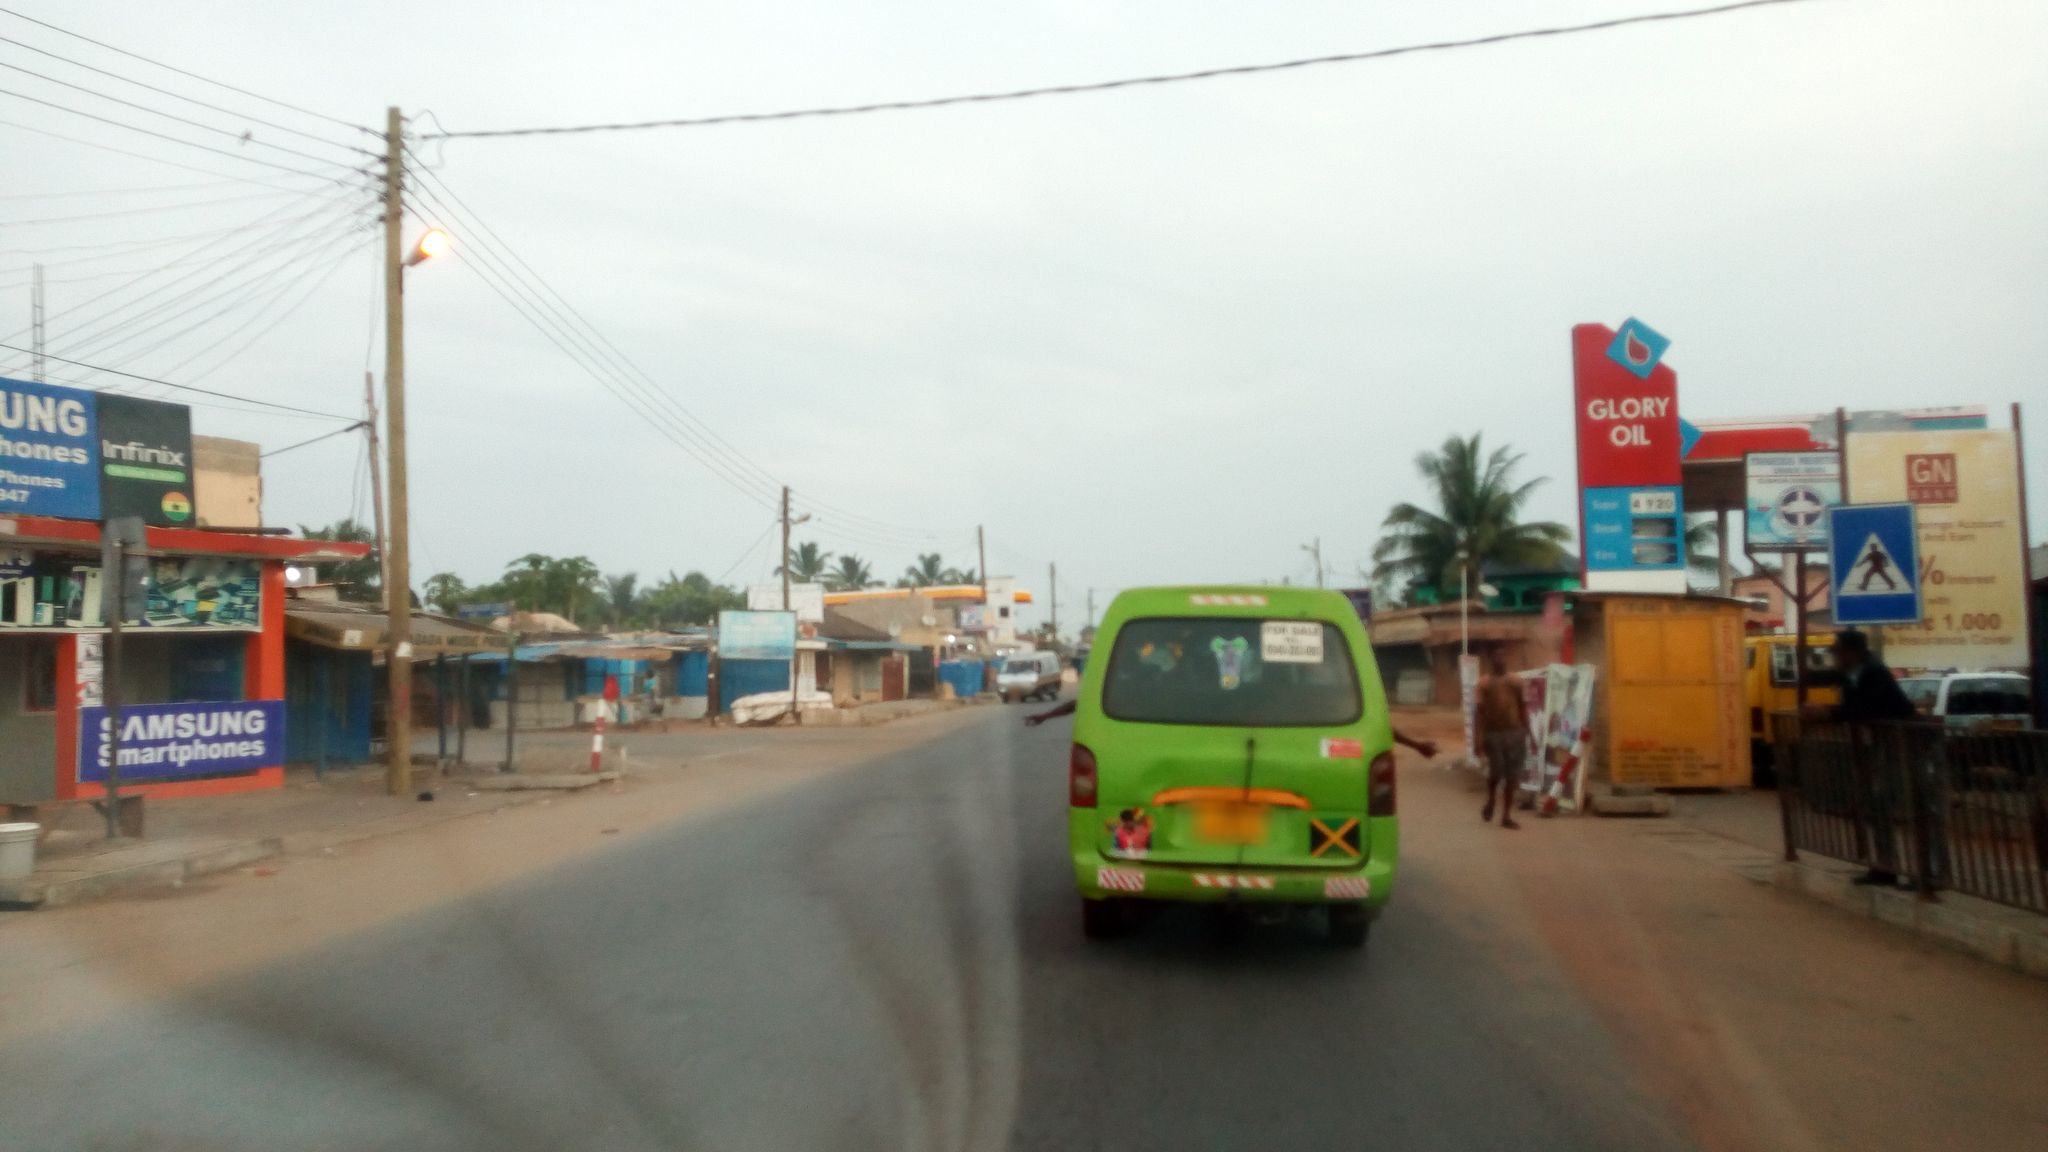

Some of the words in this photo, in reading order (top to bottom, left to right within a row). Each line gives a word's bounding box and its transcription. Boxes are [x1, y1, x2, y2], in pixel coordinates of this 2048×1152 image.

[0, 390, 88, 437] UNG
[1587, 397, 1670, 420] GLORY
[1609, 425, 1651, 447] OIL
[102, 439, 186, 467] Infinix
[1911, 458, 1952, 483] GN
[98, 709, 267, 742] SAMSUNG
[97, 737, 266, 767] Smartphones
